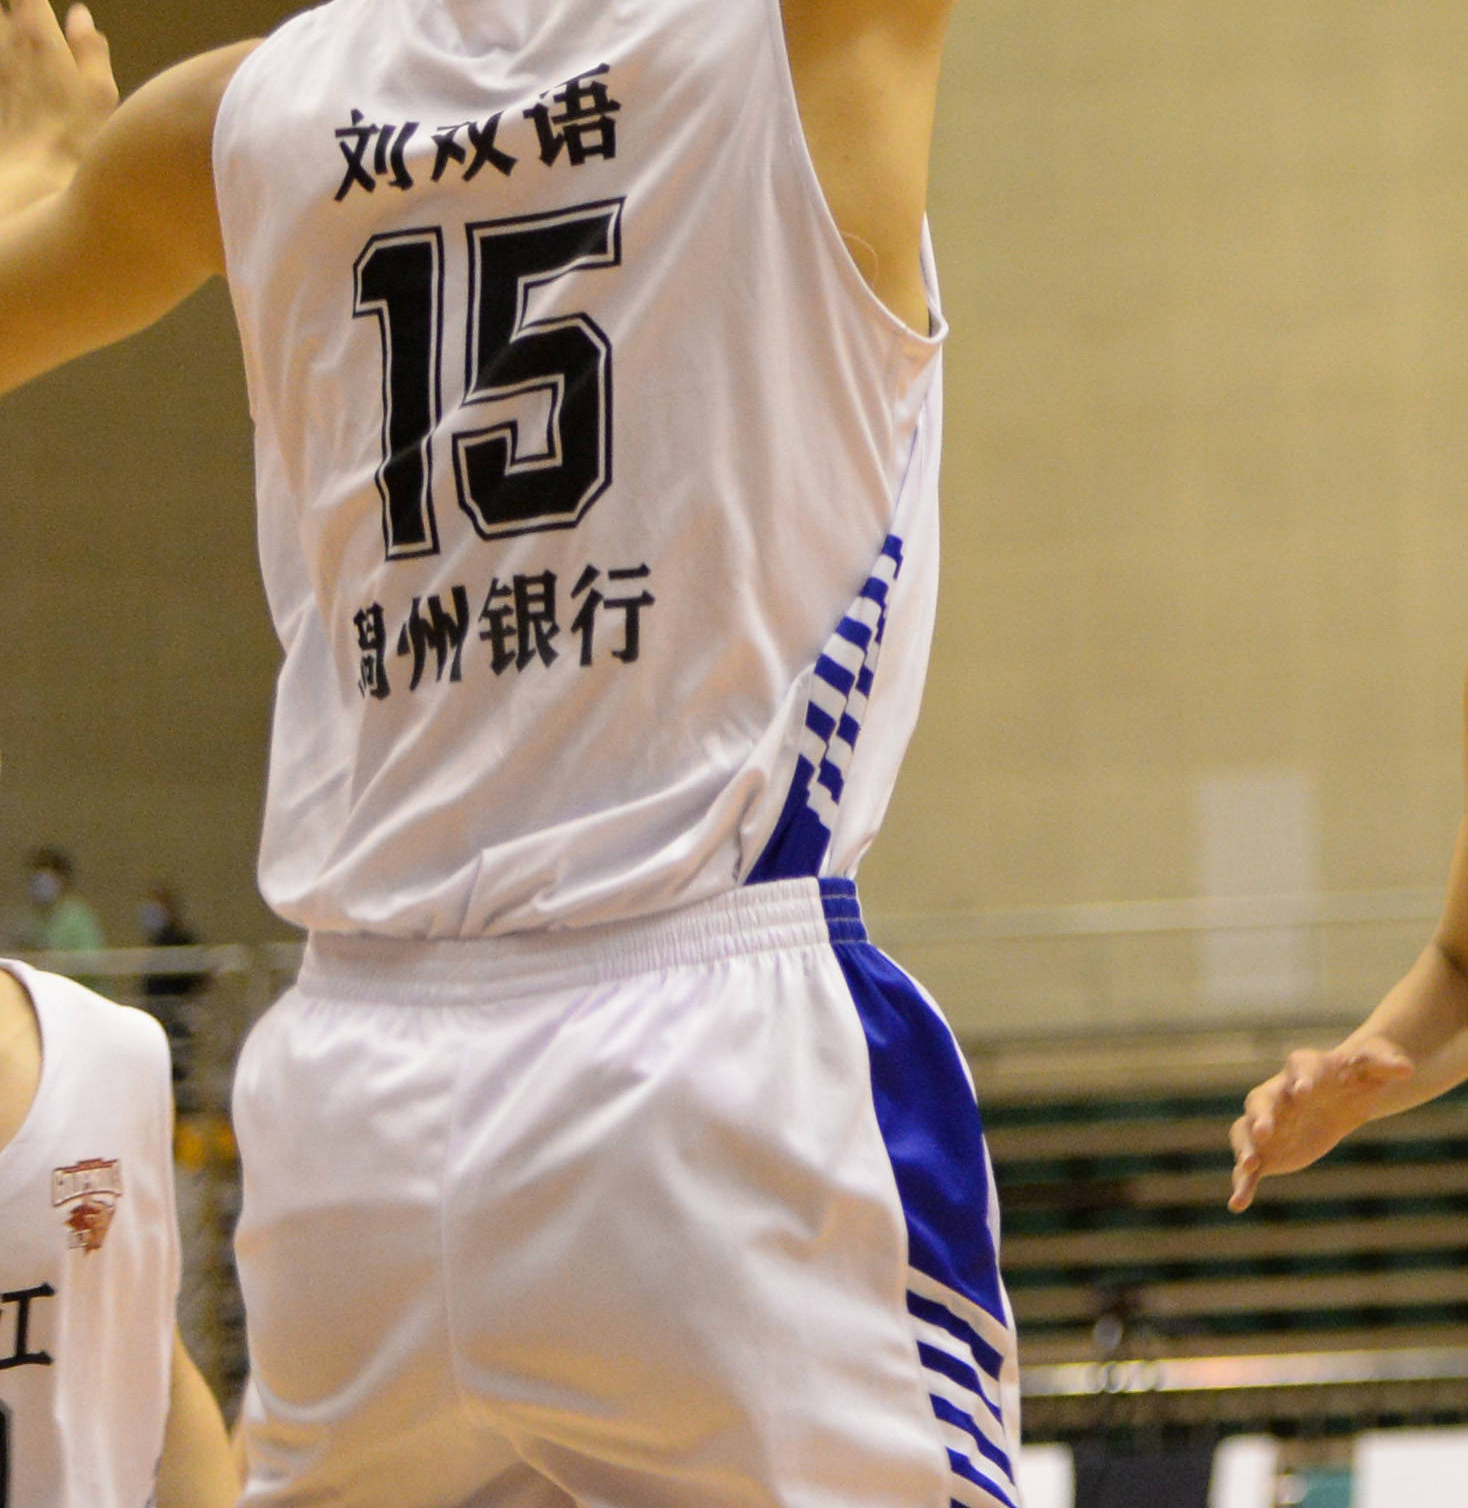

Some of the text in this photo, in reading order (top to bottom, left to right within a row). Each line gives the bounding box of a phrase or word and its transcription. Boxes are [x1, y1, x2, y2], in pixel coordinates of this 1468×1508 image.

[334, 63, 621, 201] 刘双语
[352, 195, 628, 562] 15
